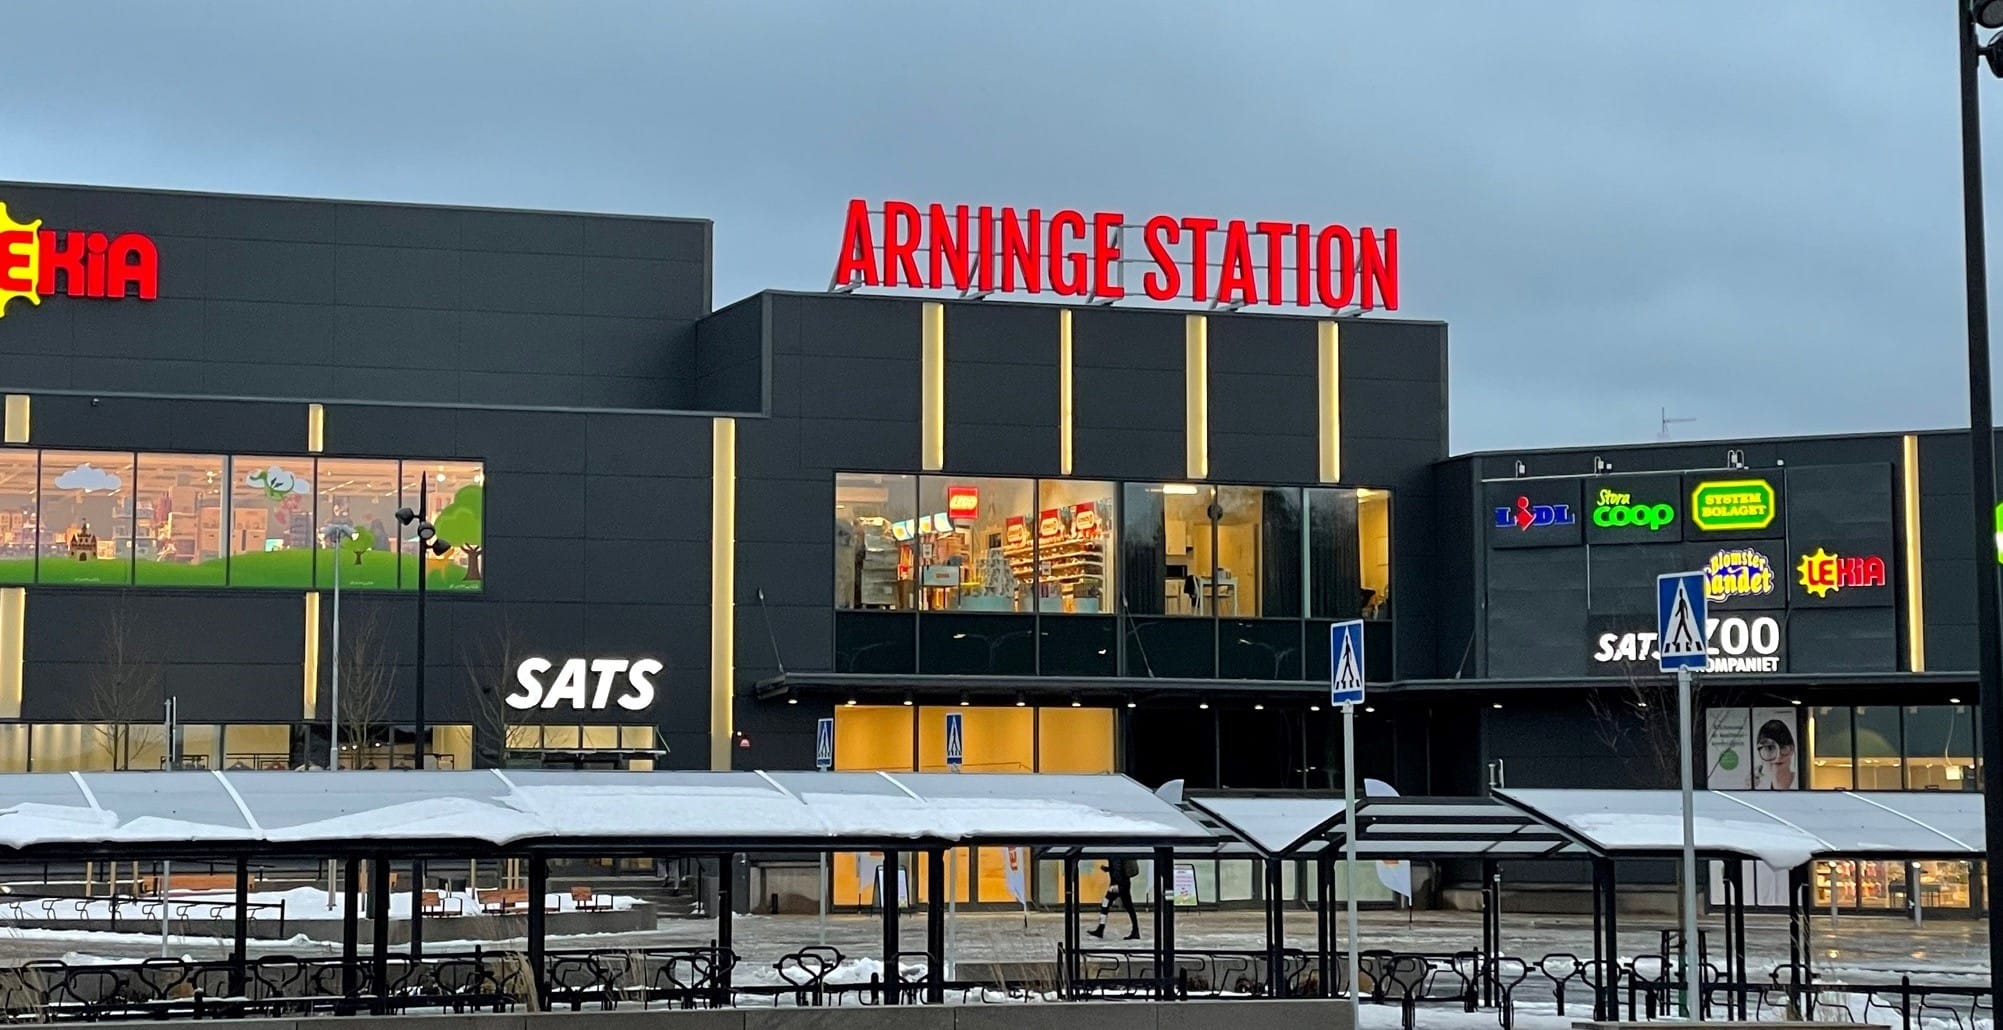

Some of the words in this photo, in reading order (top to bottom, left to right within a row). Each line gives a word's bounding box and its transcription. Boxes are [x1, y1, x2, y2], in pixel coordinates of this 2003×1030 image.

[0, 230, 159, 300] EKiA
[837, 199, 1125, 299] ARNINGE
[1142, 215, 1398, 311] STATION
[1596, 489, 1631, 506] Stora
[1705, 493, 1762, 505] SYSTEM
[1593, 504, 1675, 530] coop
[1702, 505, 1767, 517] BOLAGET
[1594, 632, 1660, 662] SAT
[1696, 657, 1780, 673] OMPANIET
[505, 657, 664, 710] SATS
